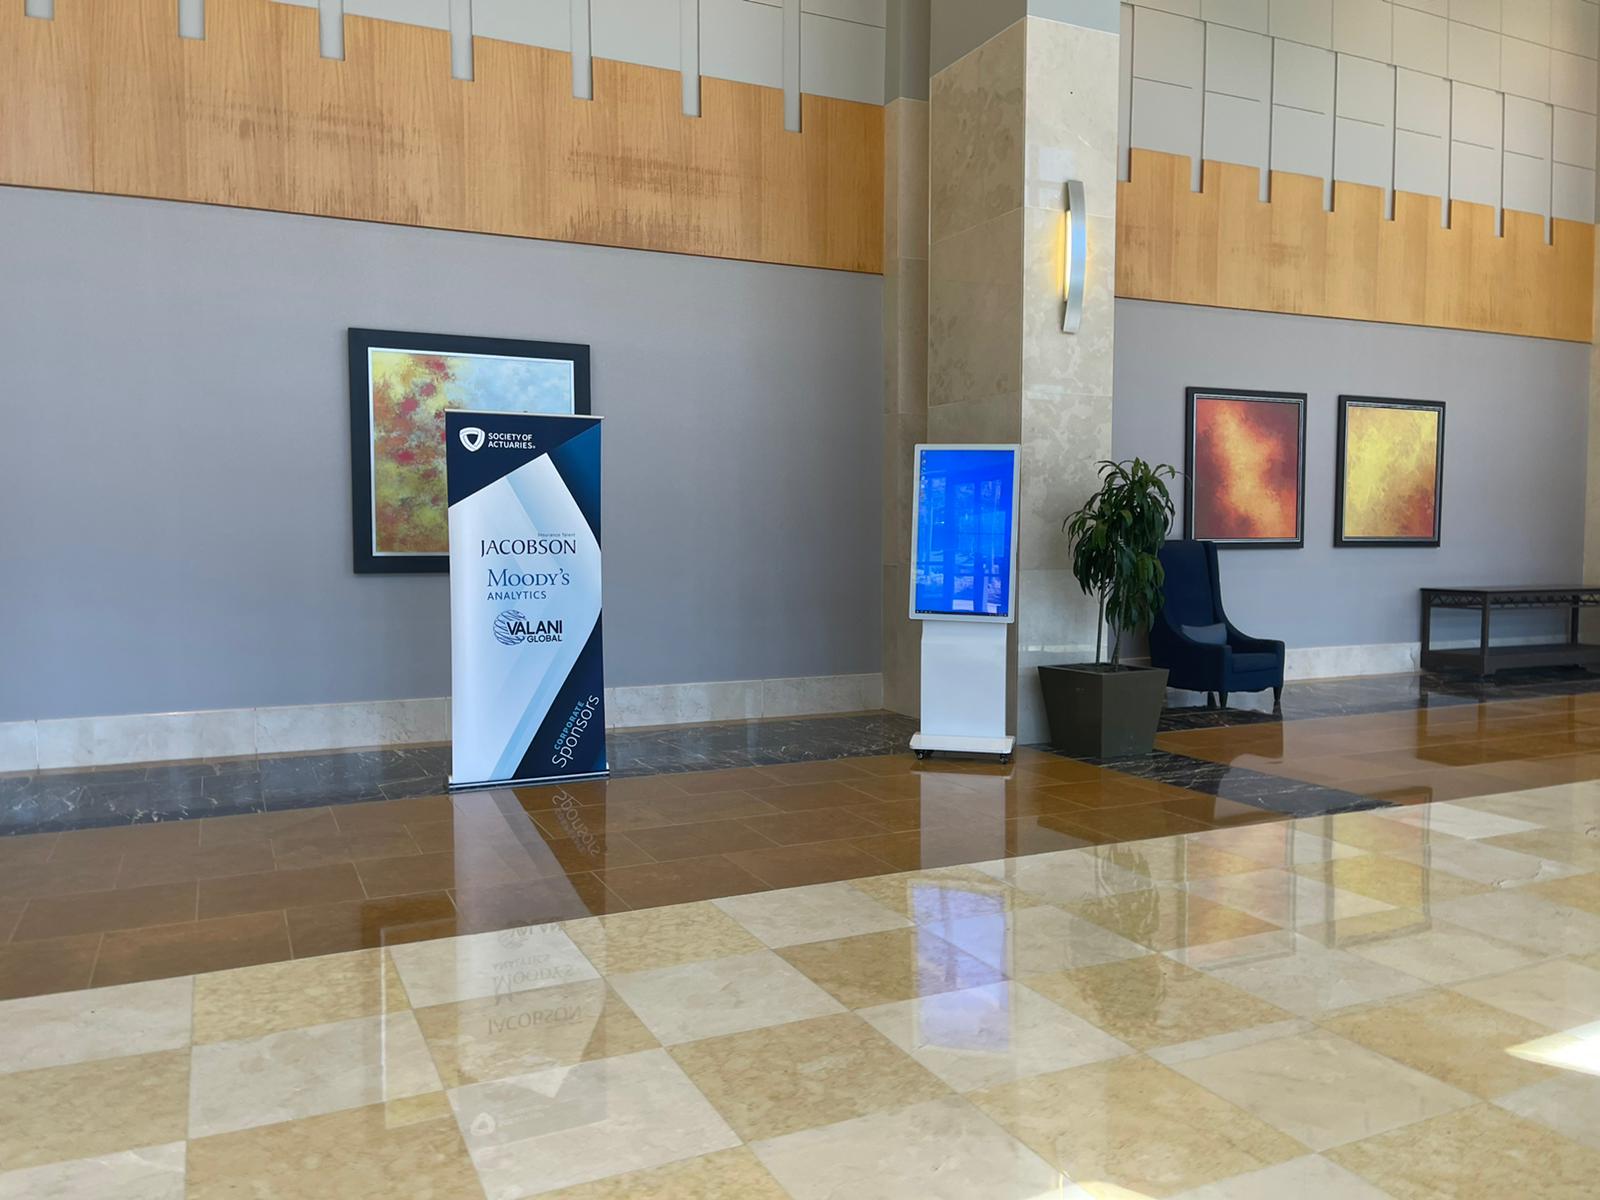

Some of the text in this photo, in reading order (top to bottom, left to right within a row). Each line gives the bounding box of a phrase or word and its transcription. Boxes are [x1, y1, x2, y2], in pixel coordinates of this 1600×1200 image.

[488, 432, 521, 441] SOCIETY
[480, 539, 576, 557] JACOBSON
[487, 590, 547, 600] ANALYTICS
[506, 620, 563, 635] VALANI
[527, 634, 563, 643] GLOBAL
[552, 695, 600, 768] Sponsors
[554, 701, 585, 750] CORPORATE
